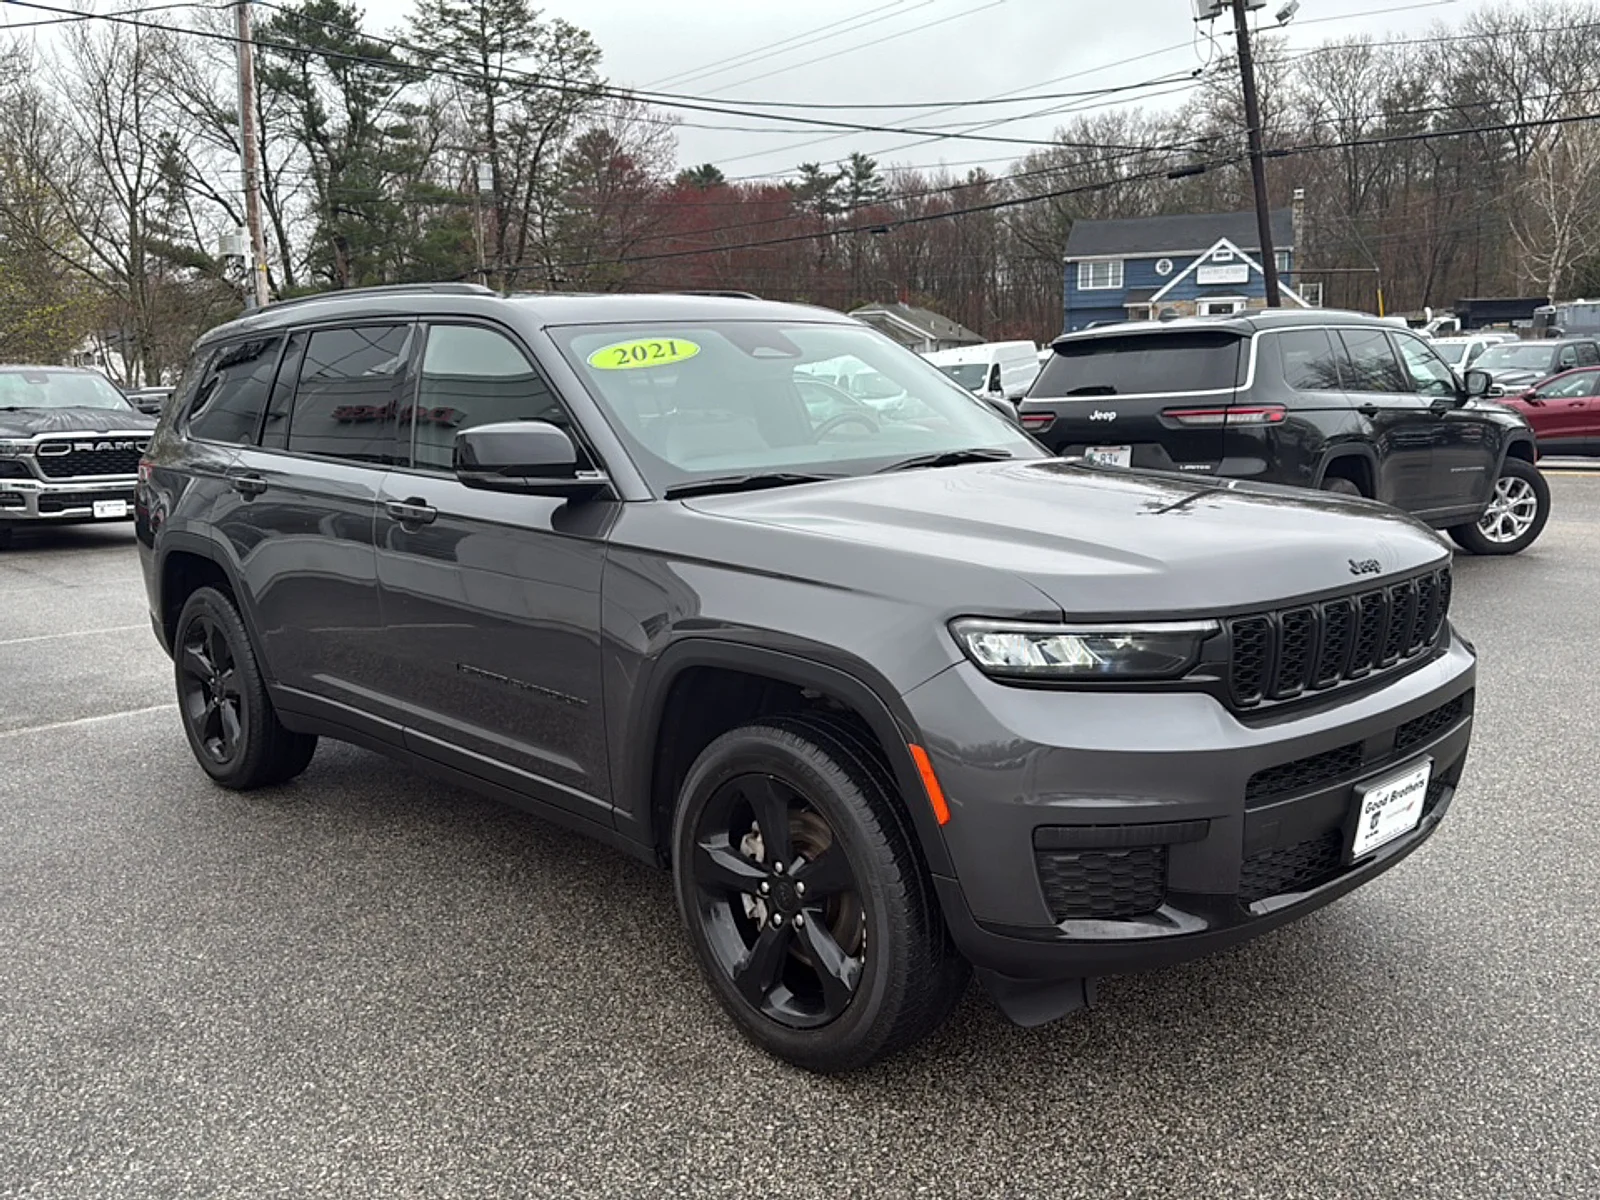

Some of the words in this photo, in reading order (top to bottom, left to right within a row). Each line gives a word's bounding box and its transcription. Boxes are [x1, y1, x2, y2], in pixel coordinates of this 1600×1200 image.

[613, 340, 679, 366] 2021
[1089, 410, 1117, 422] Jeep
[73, 441, 134, 452] RAM
[1348, 559, 1382, 576] Jeep
[1365, 793, 1390, 815] Good
[1390, 779, 1425, 803] Brothers
